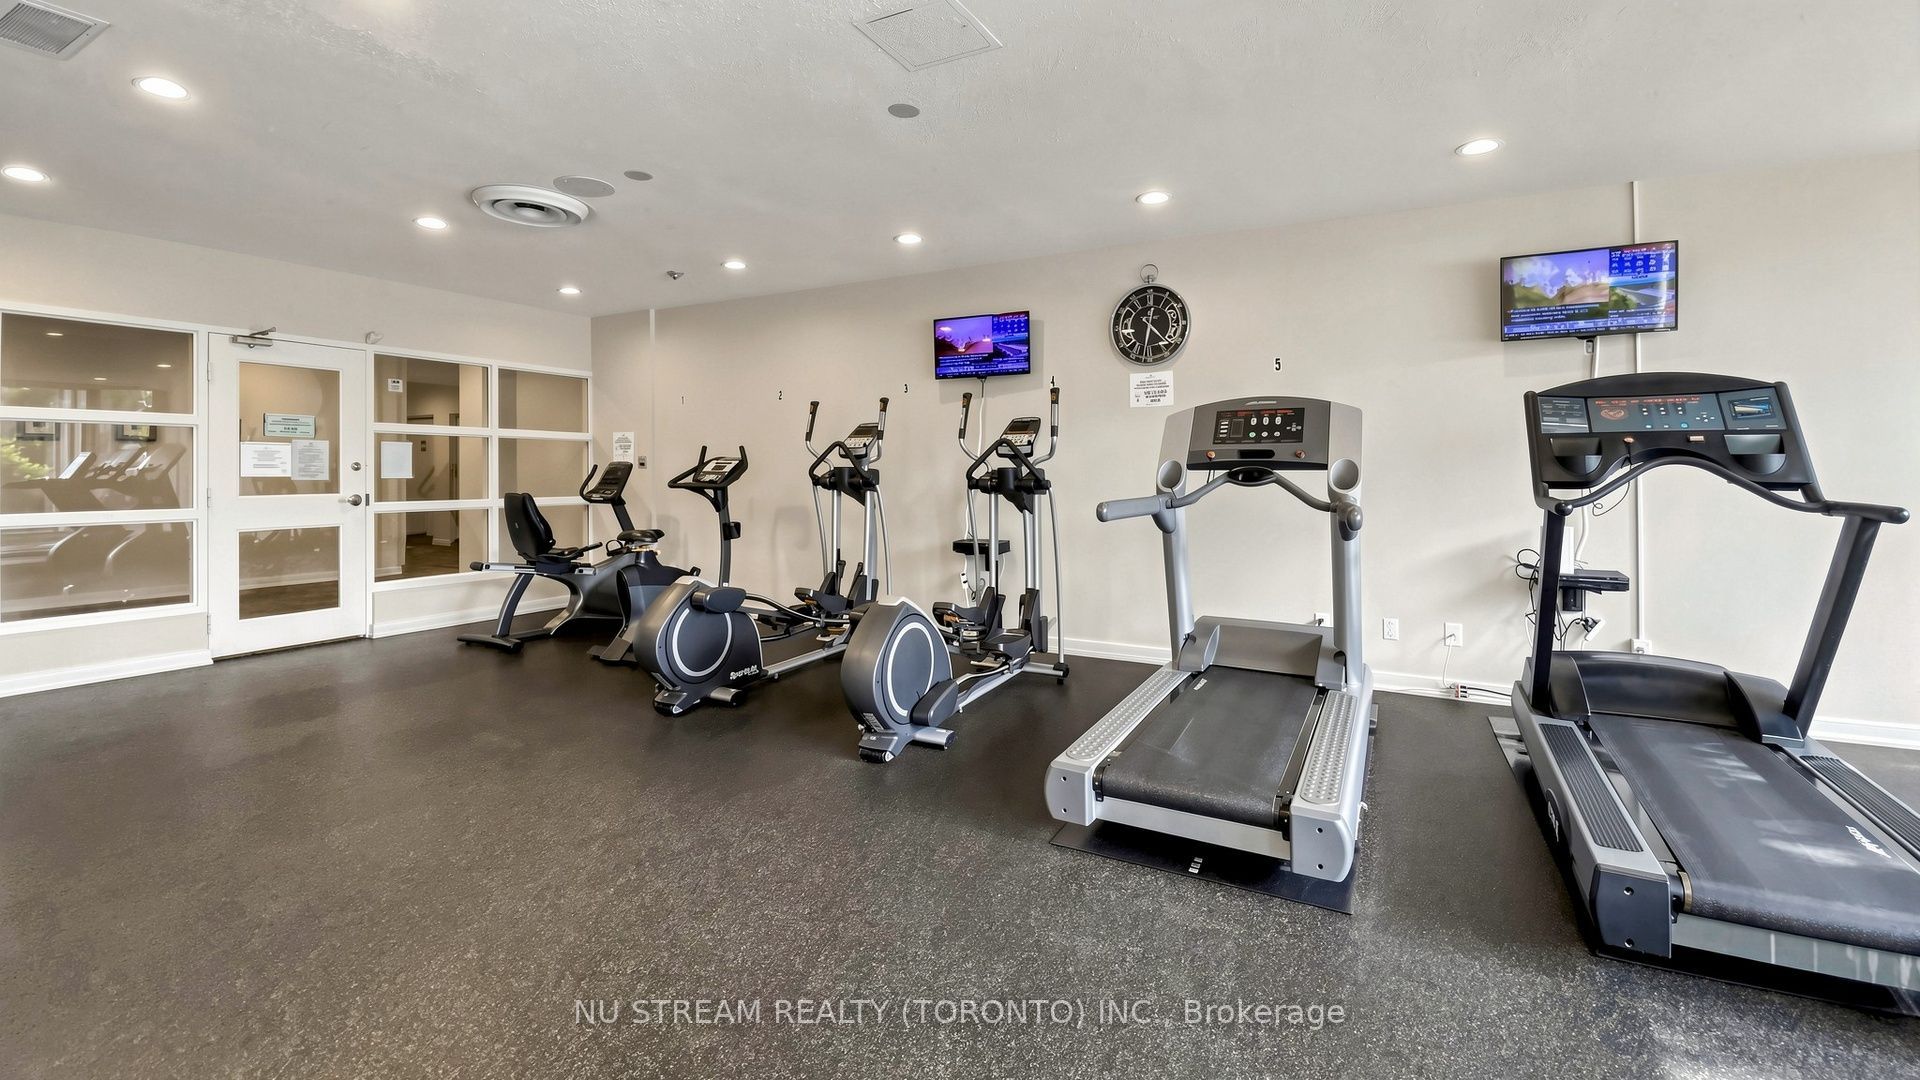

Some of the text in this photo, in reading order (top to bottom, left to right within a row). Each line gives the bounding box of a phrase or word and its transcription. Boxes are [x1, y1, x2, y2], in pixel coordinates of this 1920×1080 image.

[1275, 358, 1281, 371] 5
[904, 384, 909, 393] 3
[778, 390, 783, 400] 2
